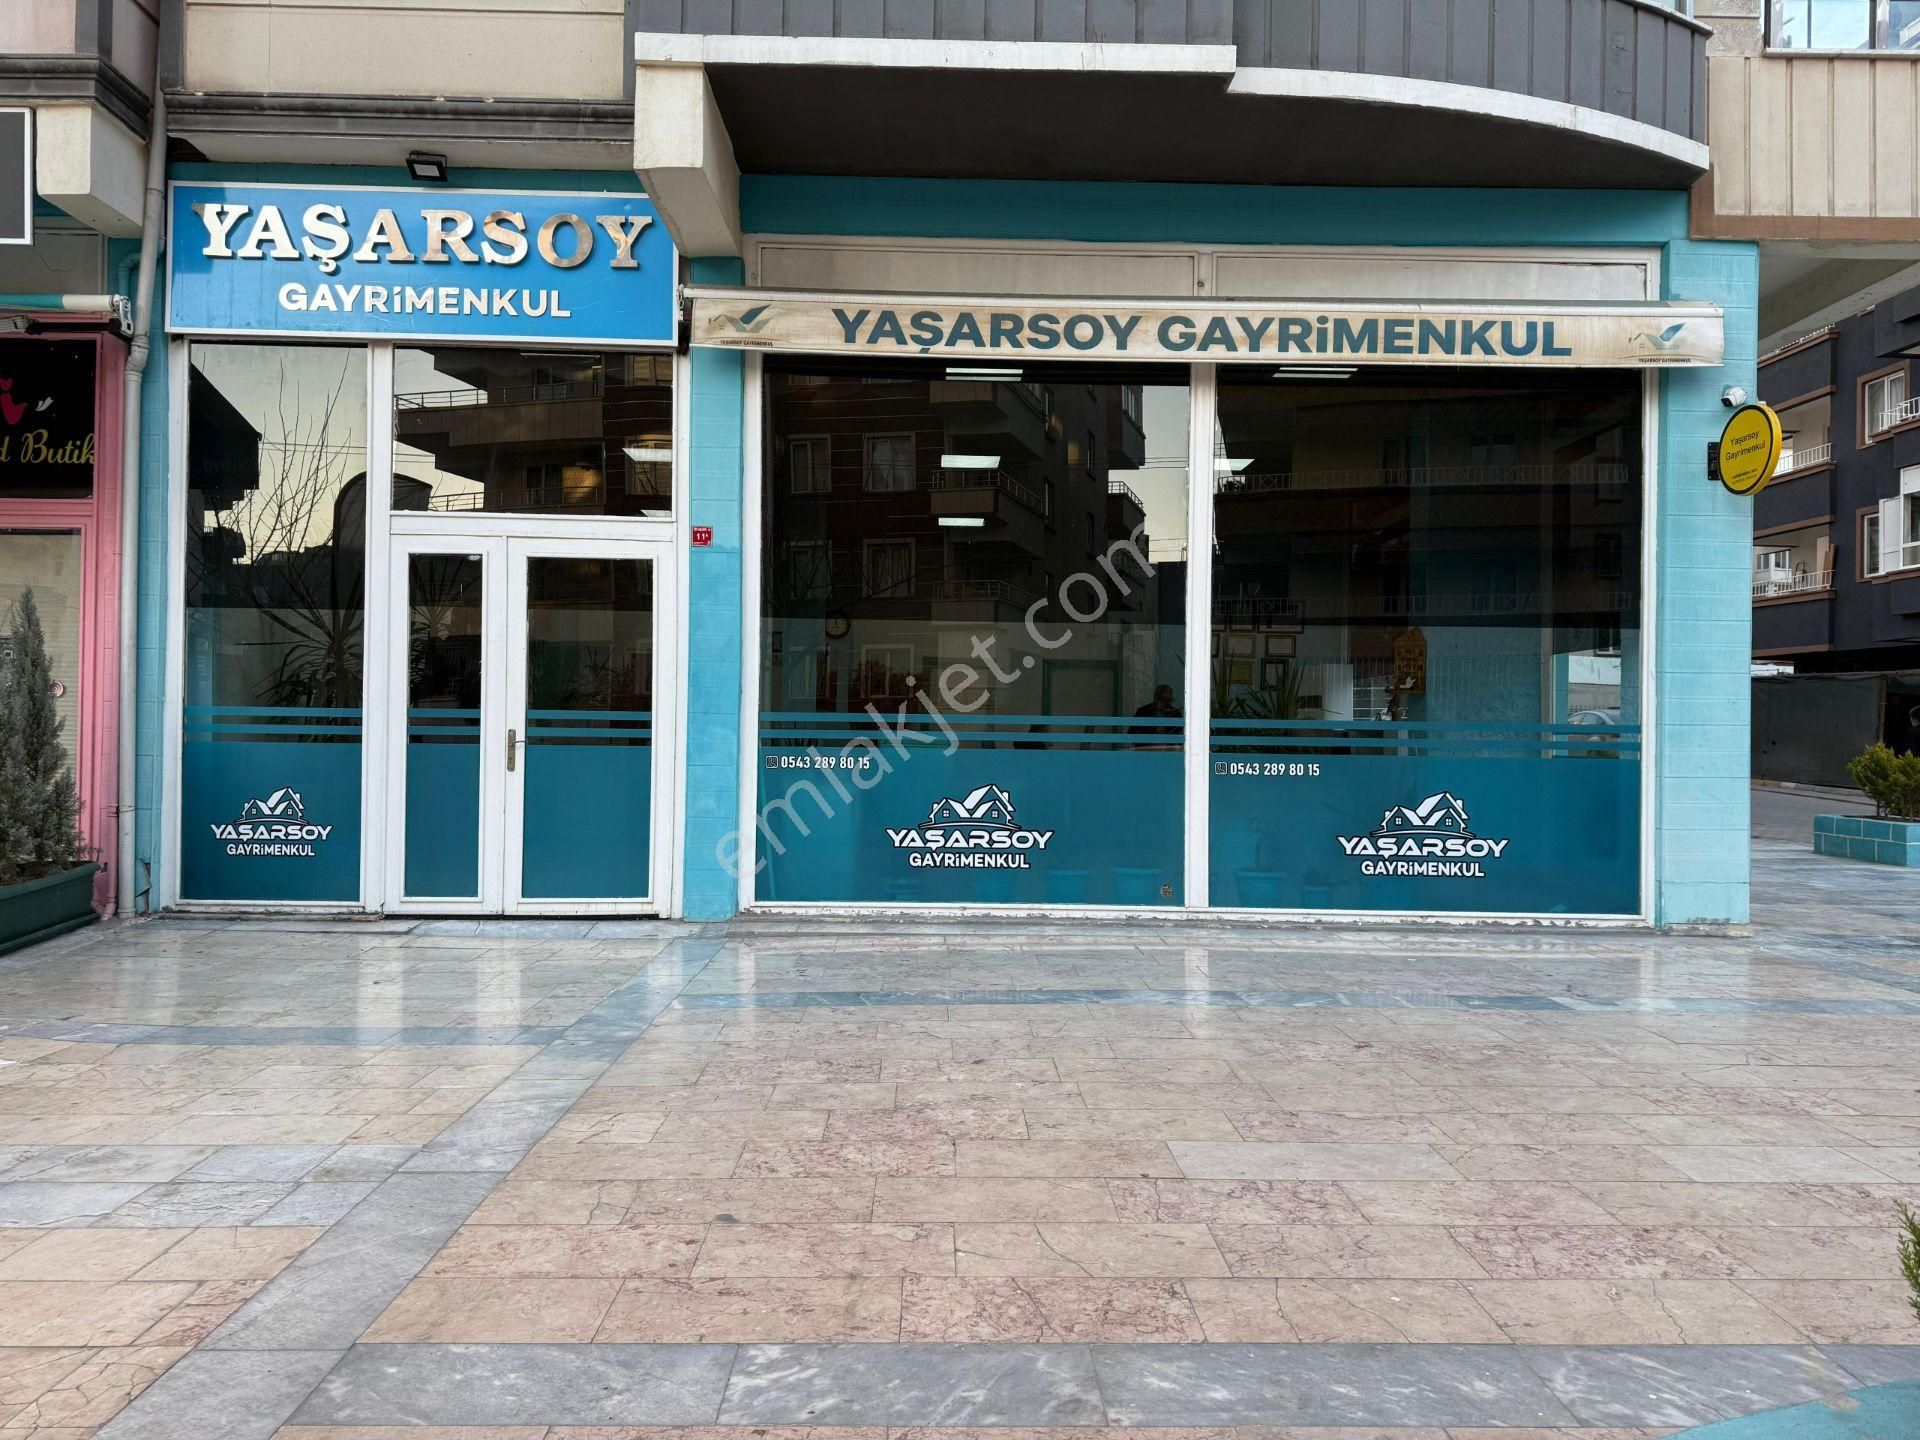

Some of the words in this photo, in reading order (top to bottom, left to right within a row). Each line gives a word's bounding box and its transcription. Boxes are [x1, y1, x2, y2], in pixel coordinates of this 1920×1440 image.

[191, 203, 654, 273] YAŞARSOY
[832, 308, 1142, 354] YAŞARSOY
[20, 429, 95, 464] Butik
[1730, 430, 1760, 447] Yaşarsoy
[780, 756, 811, 769] 0543
[814, 756, 836, 770] 289
[839, 757, 855, 770] 80
[857, 757, 871, 770] 15
[1230, 763, 1260, 776] 0543
[1263, 763, 1286, 776] 289
[1289, 764, 1305, 776] 80
[1307, 764, 1321, 777] 15
[210, 824, 333, 842] YAŞARSOY
[886, 828, 1054, 852] YAŞARSOY
[1337, 836, 1509, 860] YAŞARSOY
